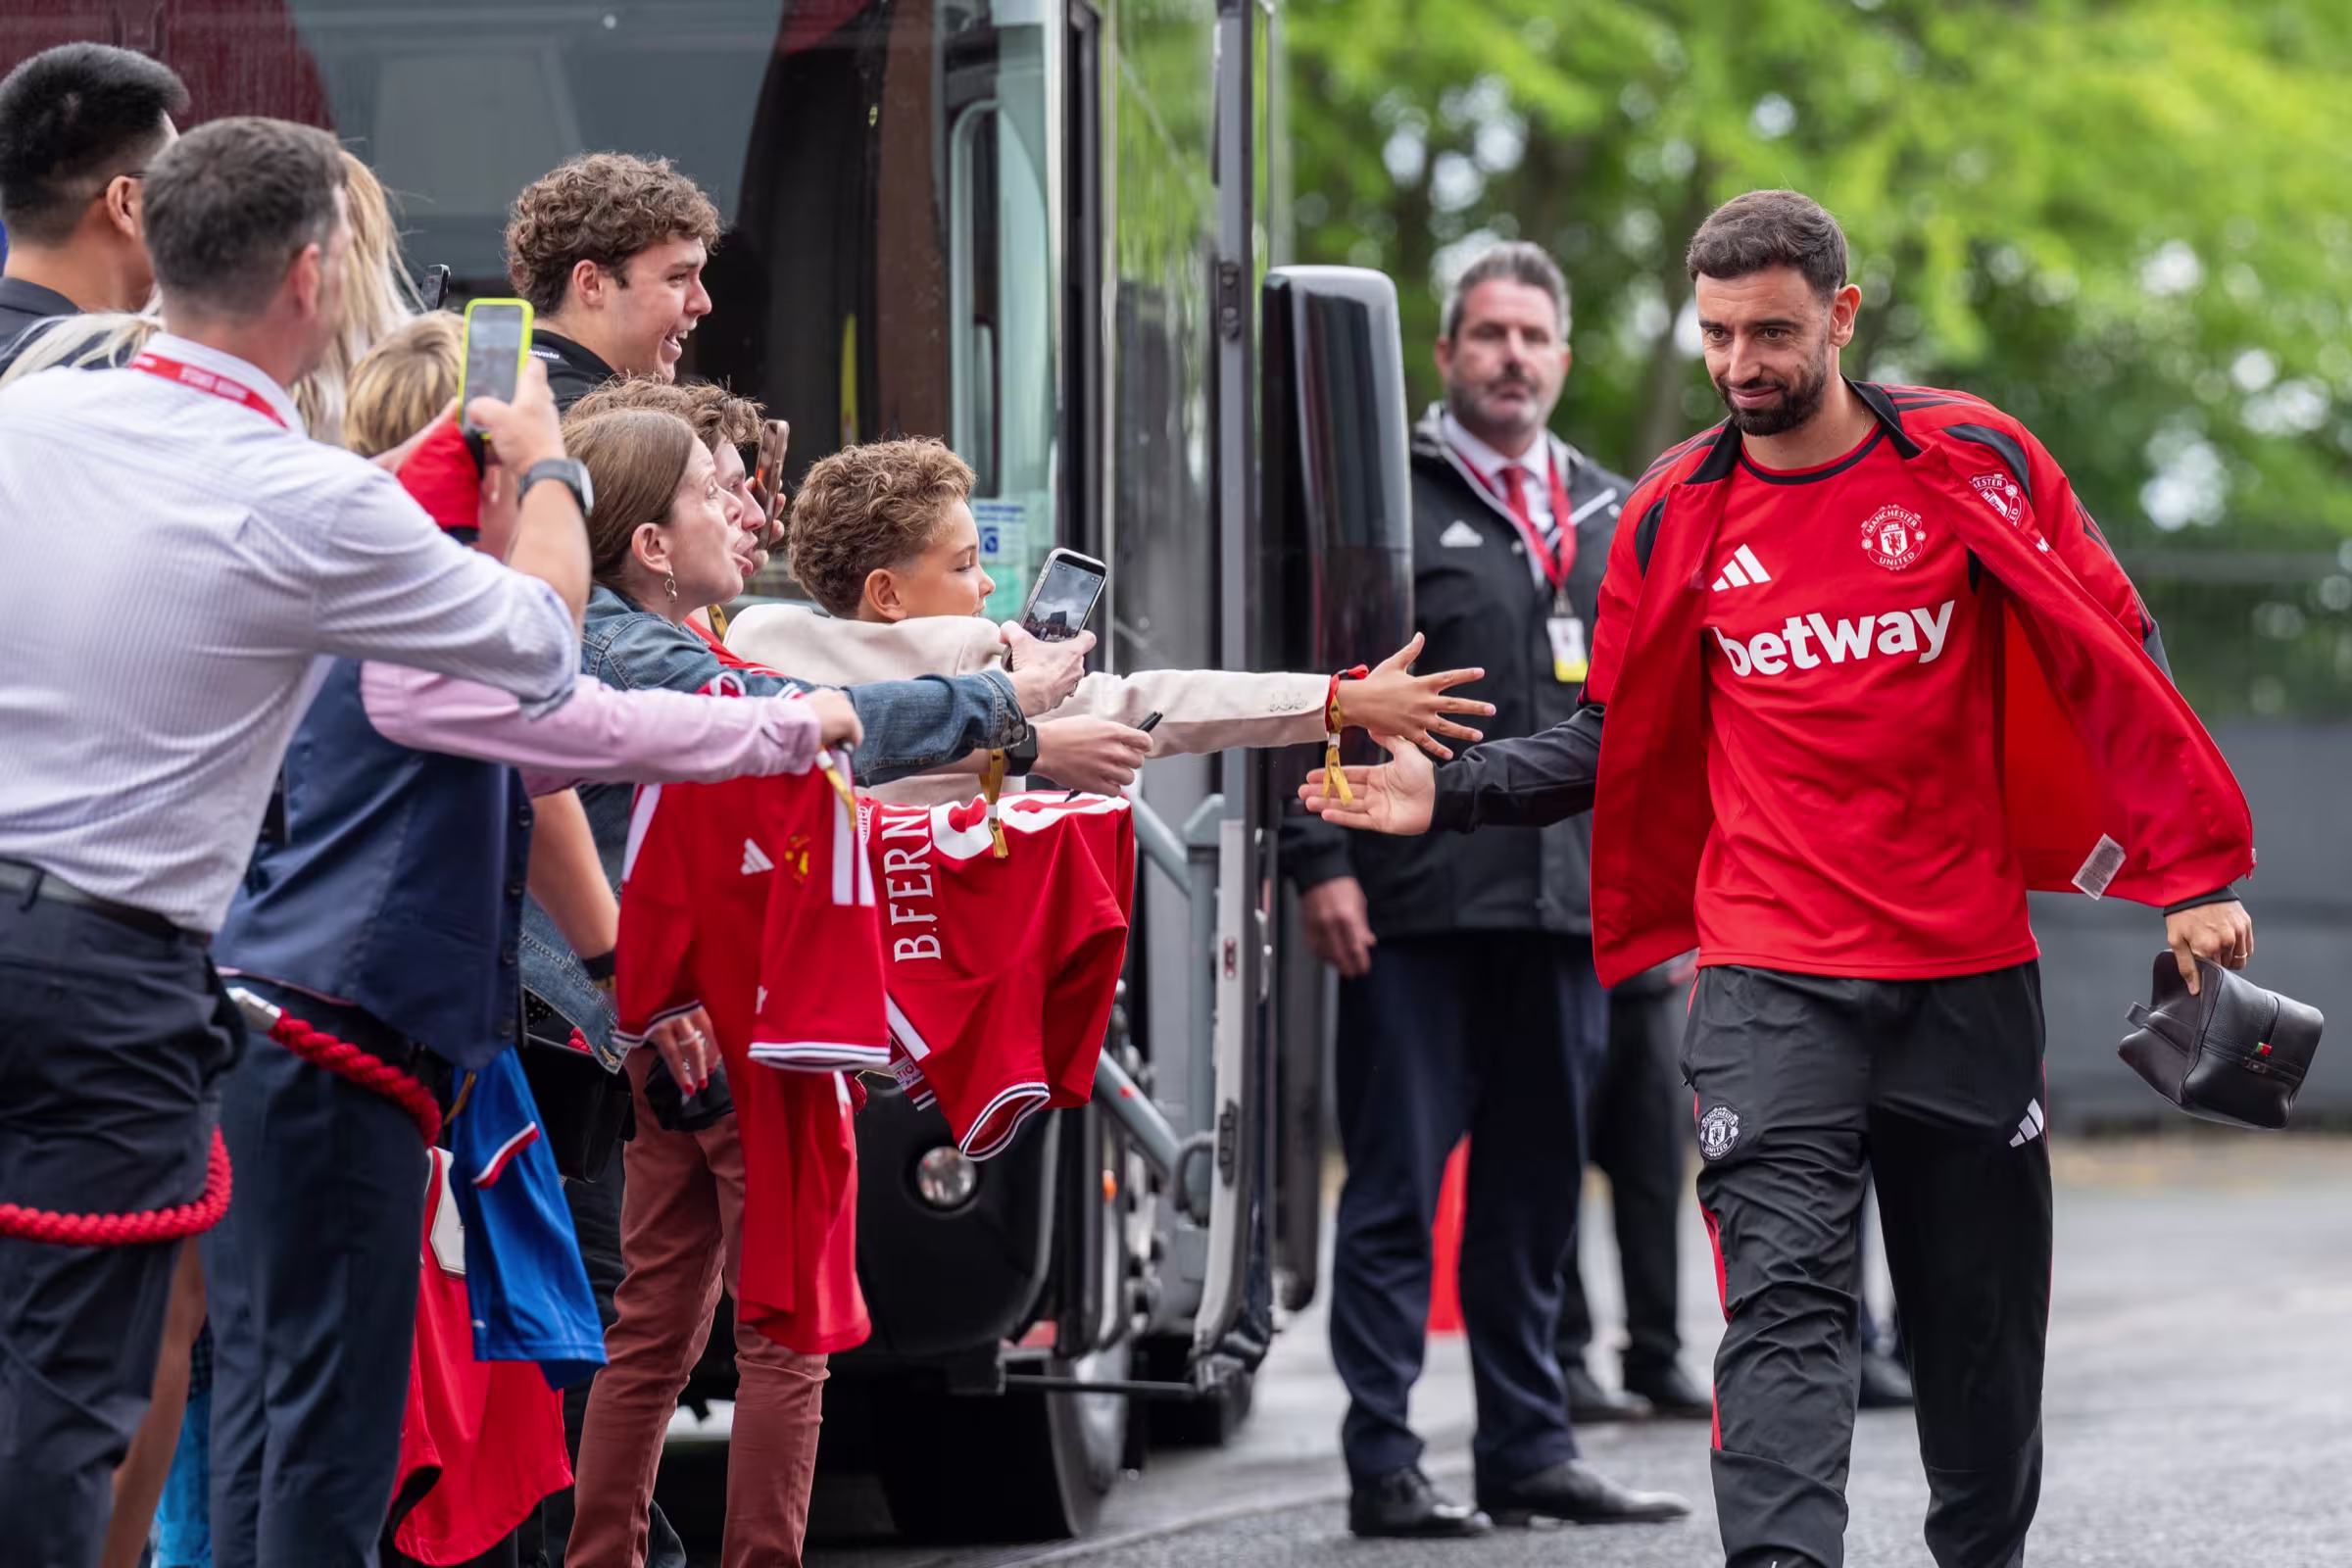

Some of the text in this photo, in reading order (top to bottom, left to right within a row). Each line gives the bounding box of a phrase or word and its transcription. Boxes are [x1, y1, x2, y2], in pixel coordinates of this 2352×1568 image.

[1866, 510, 1918, 534] MANCHESTER
[1879, 552, 1915, 565] UNITED
[1711, 600, 1955, 676] betway
[1705, 1143, 1728, 1152] UNITED
